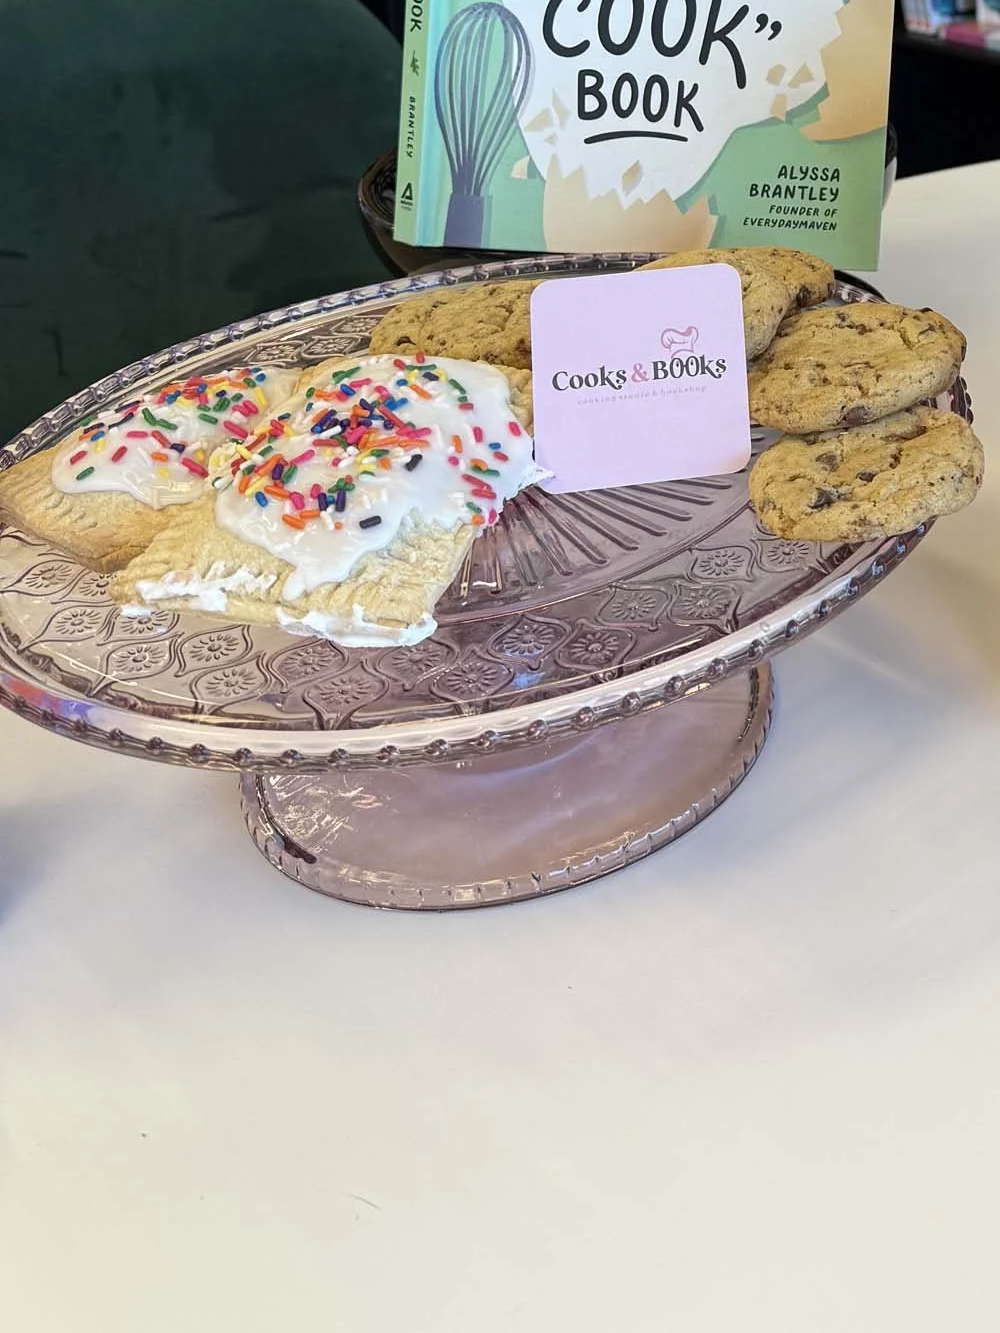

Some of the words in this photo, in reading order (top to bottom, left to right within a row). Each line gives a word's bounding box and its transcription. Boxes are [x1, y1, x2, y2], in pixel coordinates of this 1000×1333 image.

[577, 68, 704, 132] BOOK
[406, 97, 416, 158] BRANTLEY
[778, 165, 840, 182] ALYSSA
[749, 183, 839, 202] BRANTLEY
[769, 205, 820, 217] FOUNDER
[824, 208, 838, 218] OF
[743, 217, 838, 231] EVERYDAYMAVEN
[552, 366, 627, 391] Cooks
[631, 363, 650, 383] &
